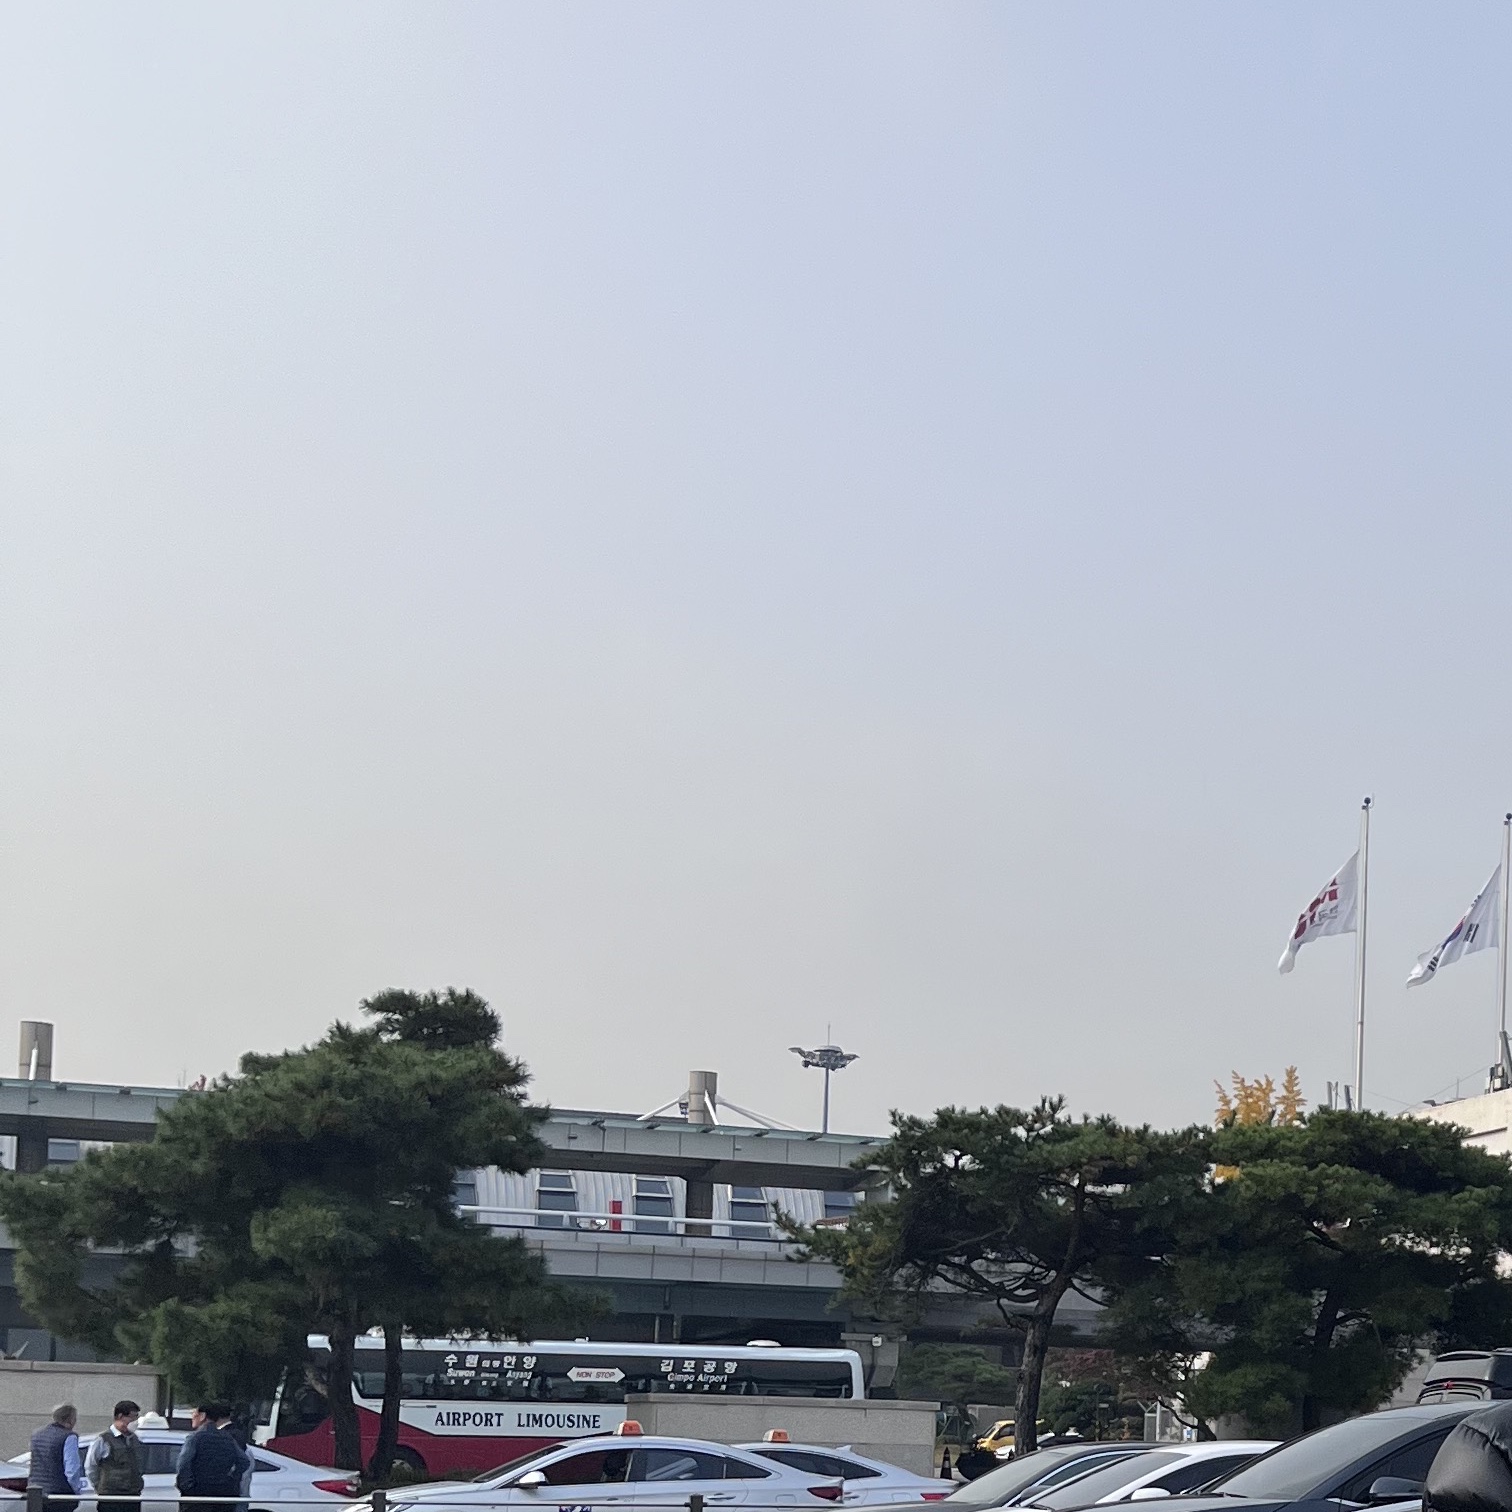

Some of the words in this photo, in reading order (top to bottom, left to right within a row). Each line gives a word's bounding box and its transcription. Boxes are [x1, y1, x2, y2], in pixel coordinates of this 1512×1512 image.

[503, 1355, 537, 1369] 안양
[660, 1359, 738, 1374] 김포공항
[595, 1371, 616, 1379] STOP
[435, 1411, 504, 1427] AIRPORT
[517, 1413, 601, 1429] LIMOUSINE
